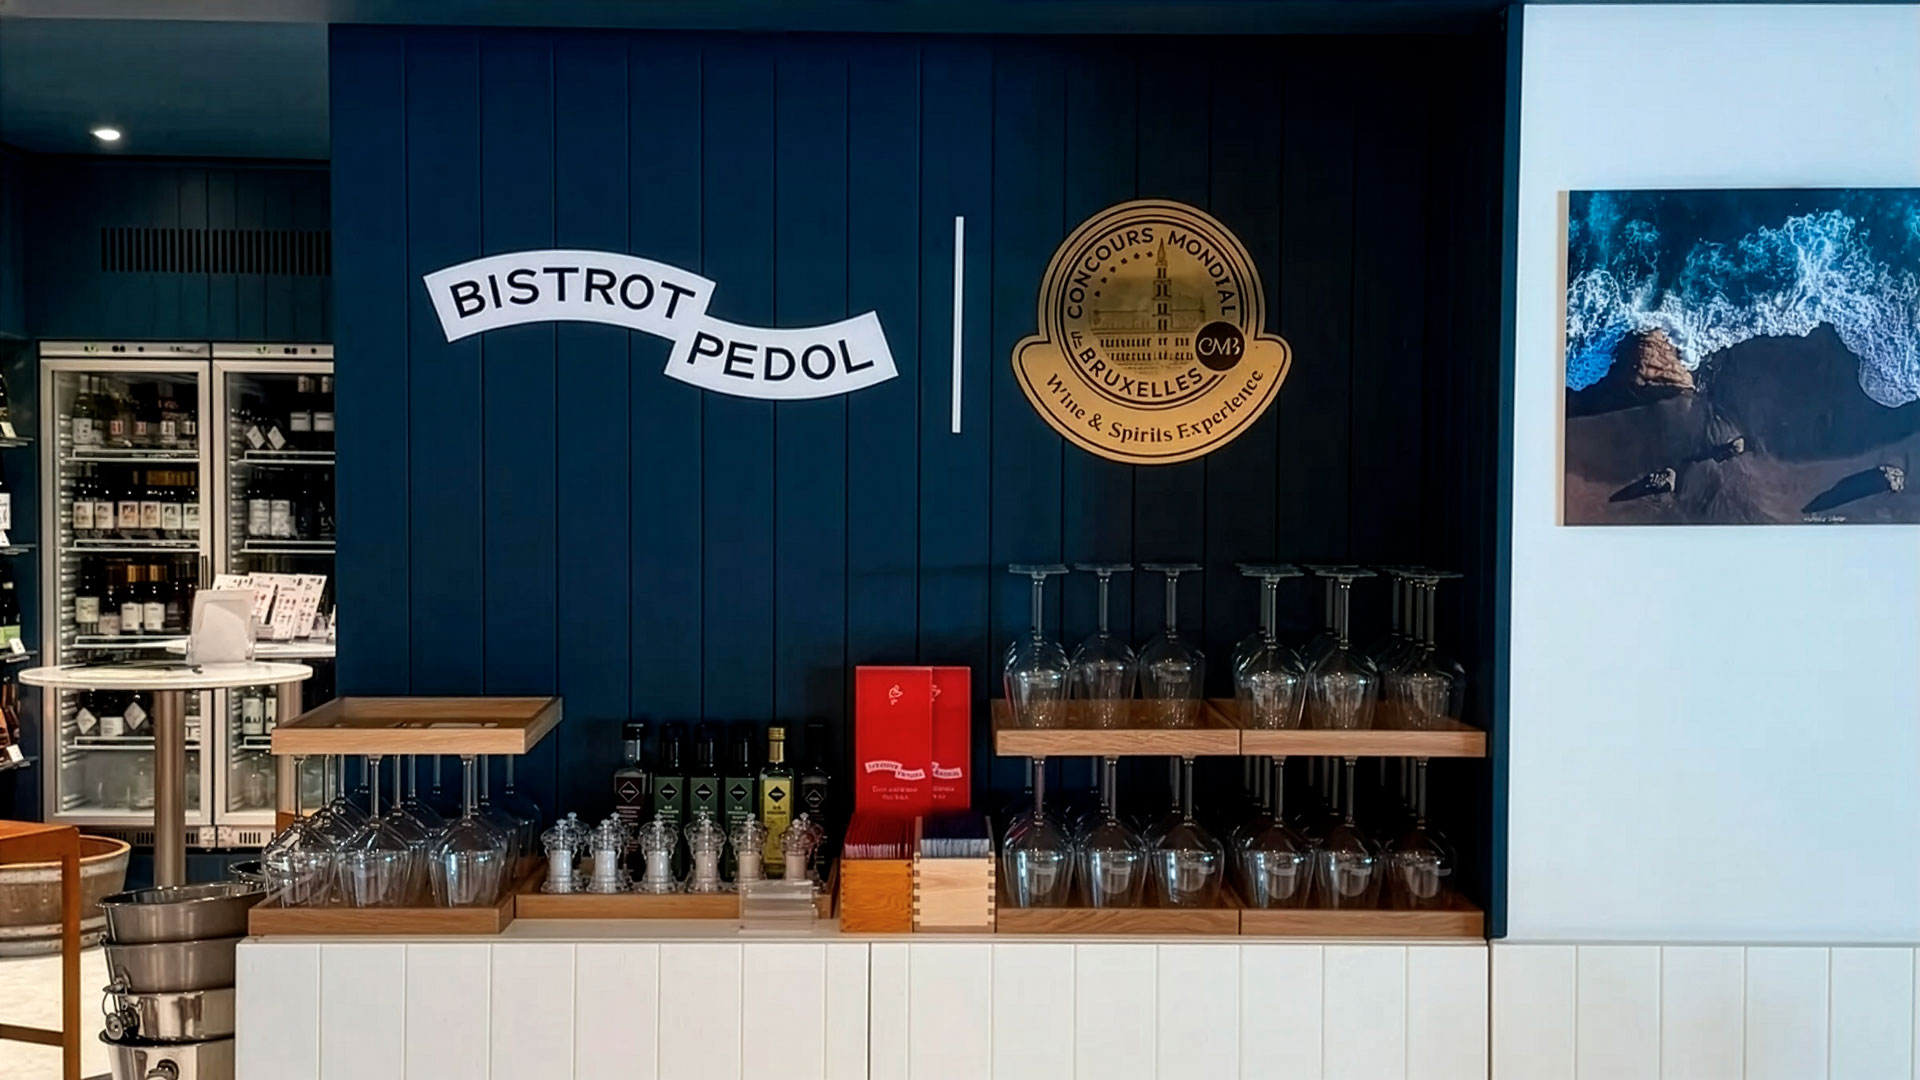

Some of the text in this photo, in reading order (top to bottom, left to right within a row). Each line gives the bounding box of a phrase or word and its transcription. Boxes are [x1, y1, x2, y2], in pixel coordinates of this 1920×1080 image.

[1067, 227, 1237, 319] CONCOURS MONDIAL
[449, 267, 874, 381] BISTROT PEDOL
[1046, 369, 1264, 443] Wine & Spirits Experience
[1079, 347, 1203, 398] BRUXELLES
